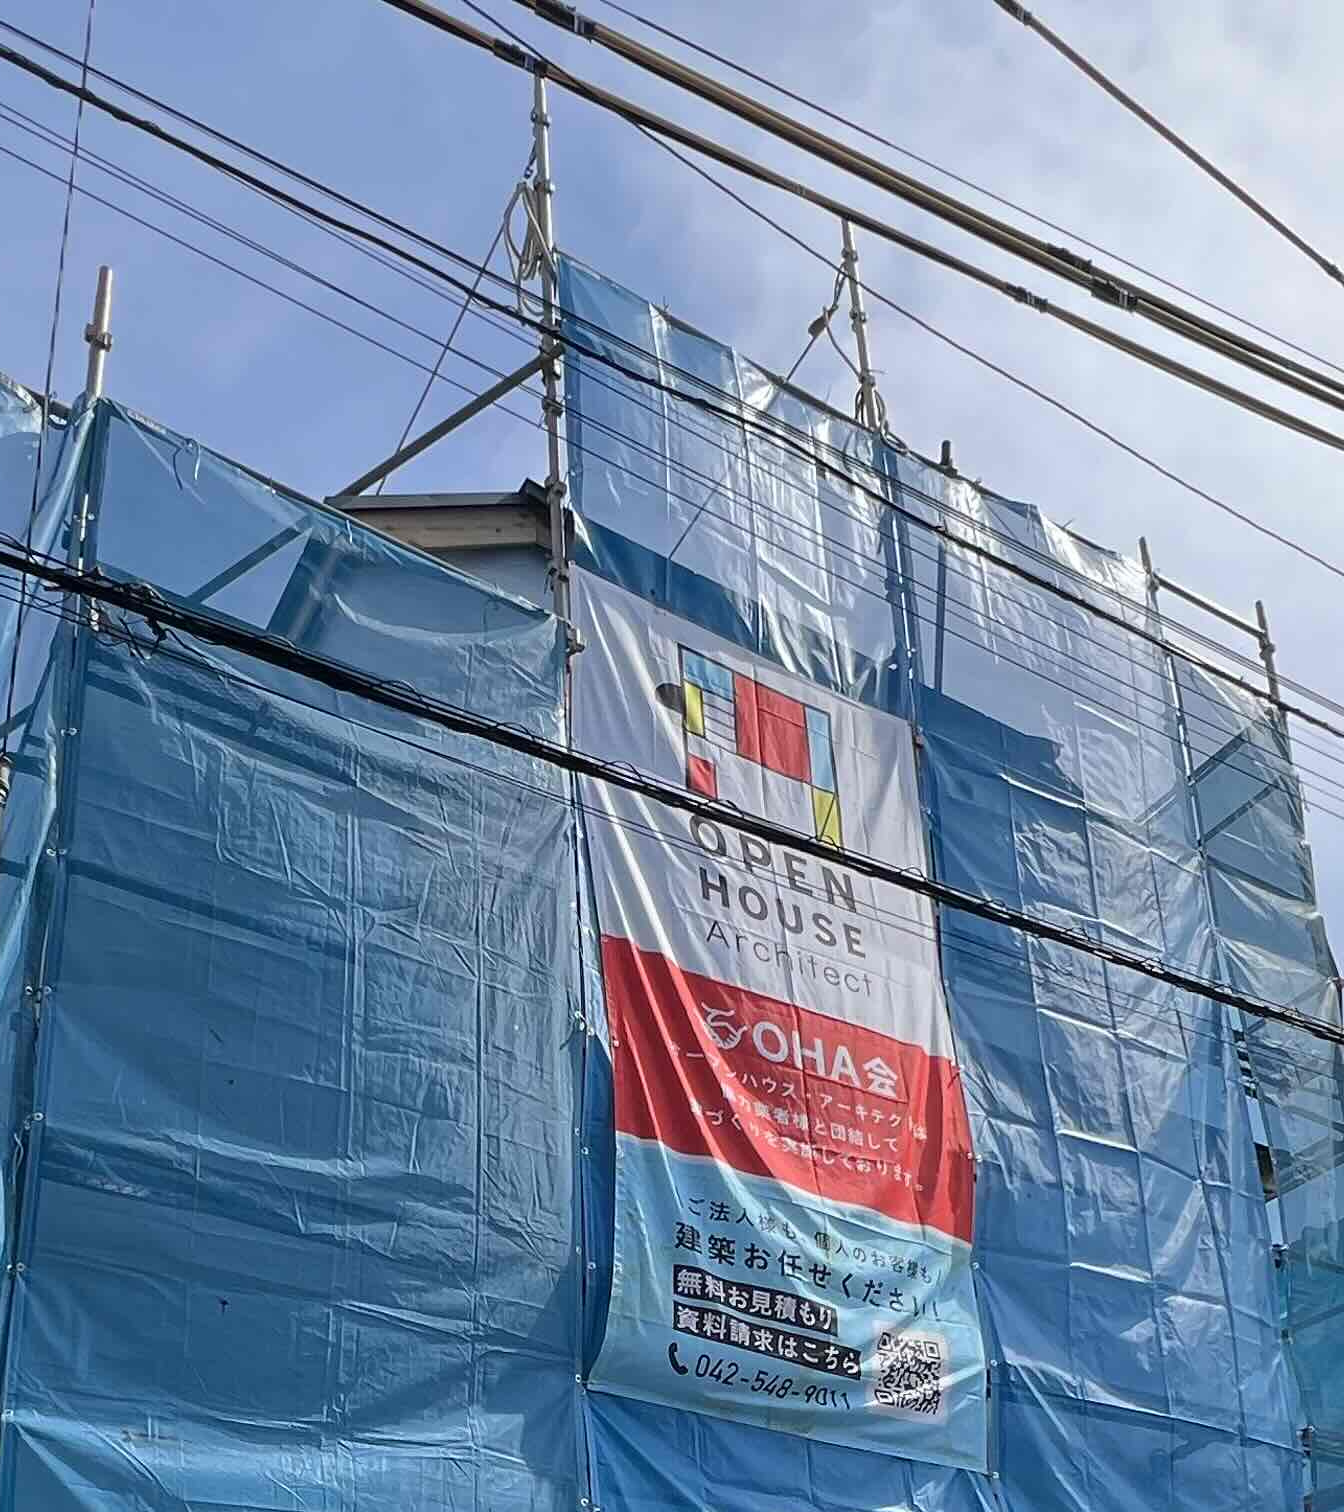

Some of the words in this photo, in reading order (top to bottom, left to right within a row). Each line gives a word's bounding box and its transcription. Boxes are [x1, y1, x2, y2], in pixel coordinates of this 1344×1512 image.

[690, 816, 857, 914] OPEN
[699, 867, 867, 960] HOUSE
[707, 920, 872, 996] Architect
[752, 1020, 898, 1098] OHA会
[676, 1268, 833, 1330] 無料お見積もり
[676, 1307, 860, 1375] 資料請求はこちら
[695, 1354, 852, 1411] 042-548-9011
